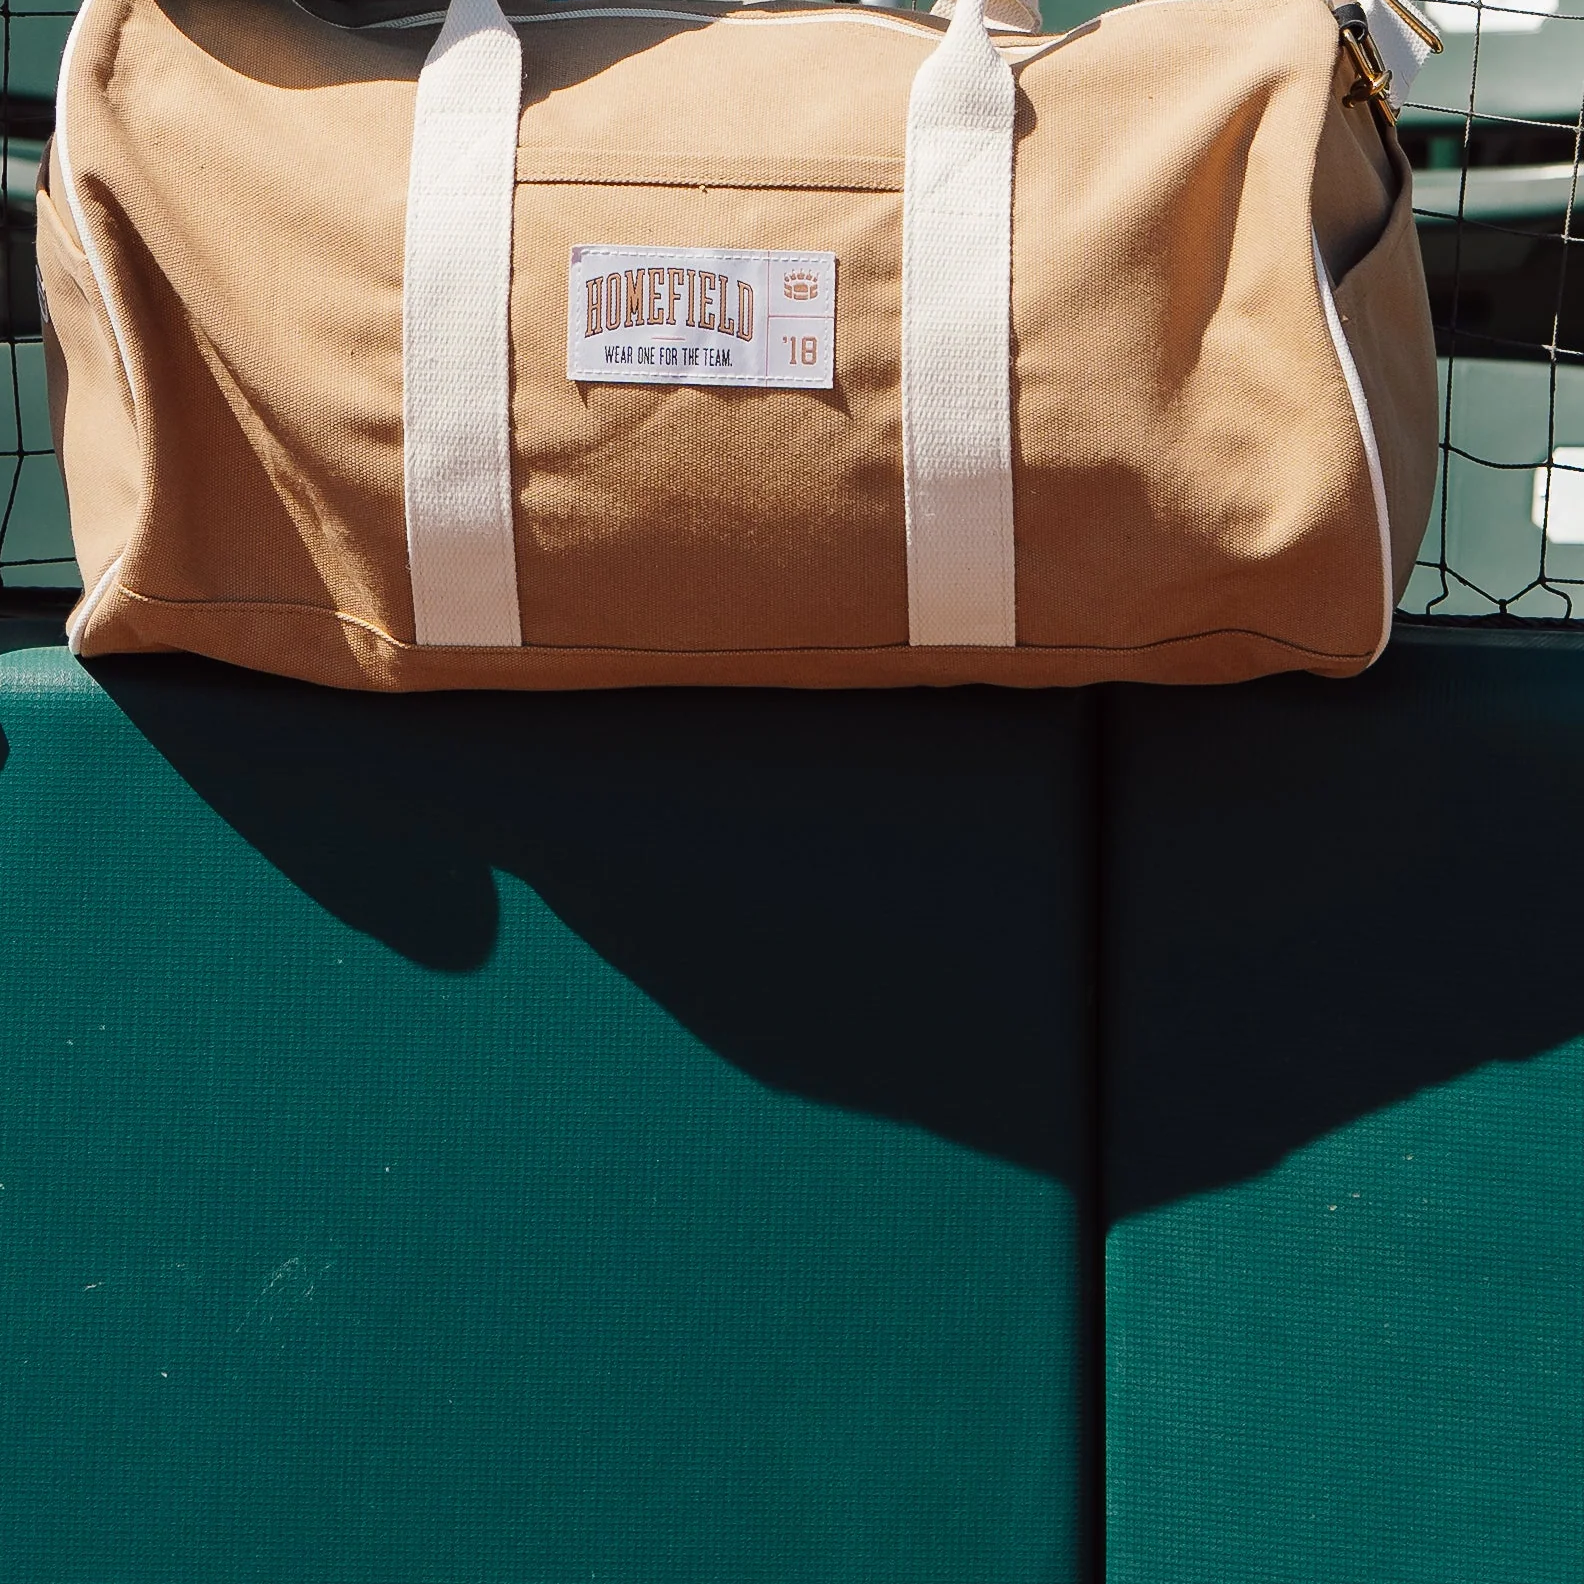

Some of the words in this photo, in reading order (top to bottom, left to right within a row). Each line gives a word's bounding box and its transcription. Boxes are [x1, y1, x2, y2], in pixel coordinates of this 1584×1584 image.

[584, 267, 754, 343] HOMEFIELD
[604, 346, 633, 364] WEAR
[637, 346, 655, 365] ONE
[659, 347, 677, 365] FOR
[682, 347, 700, 366] THE
[703, 348, 733, 367] TEAM.
[782, 335, 817, 365] '18
